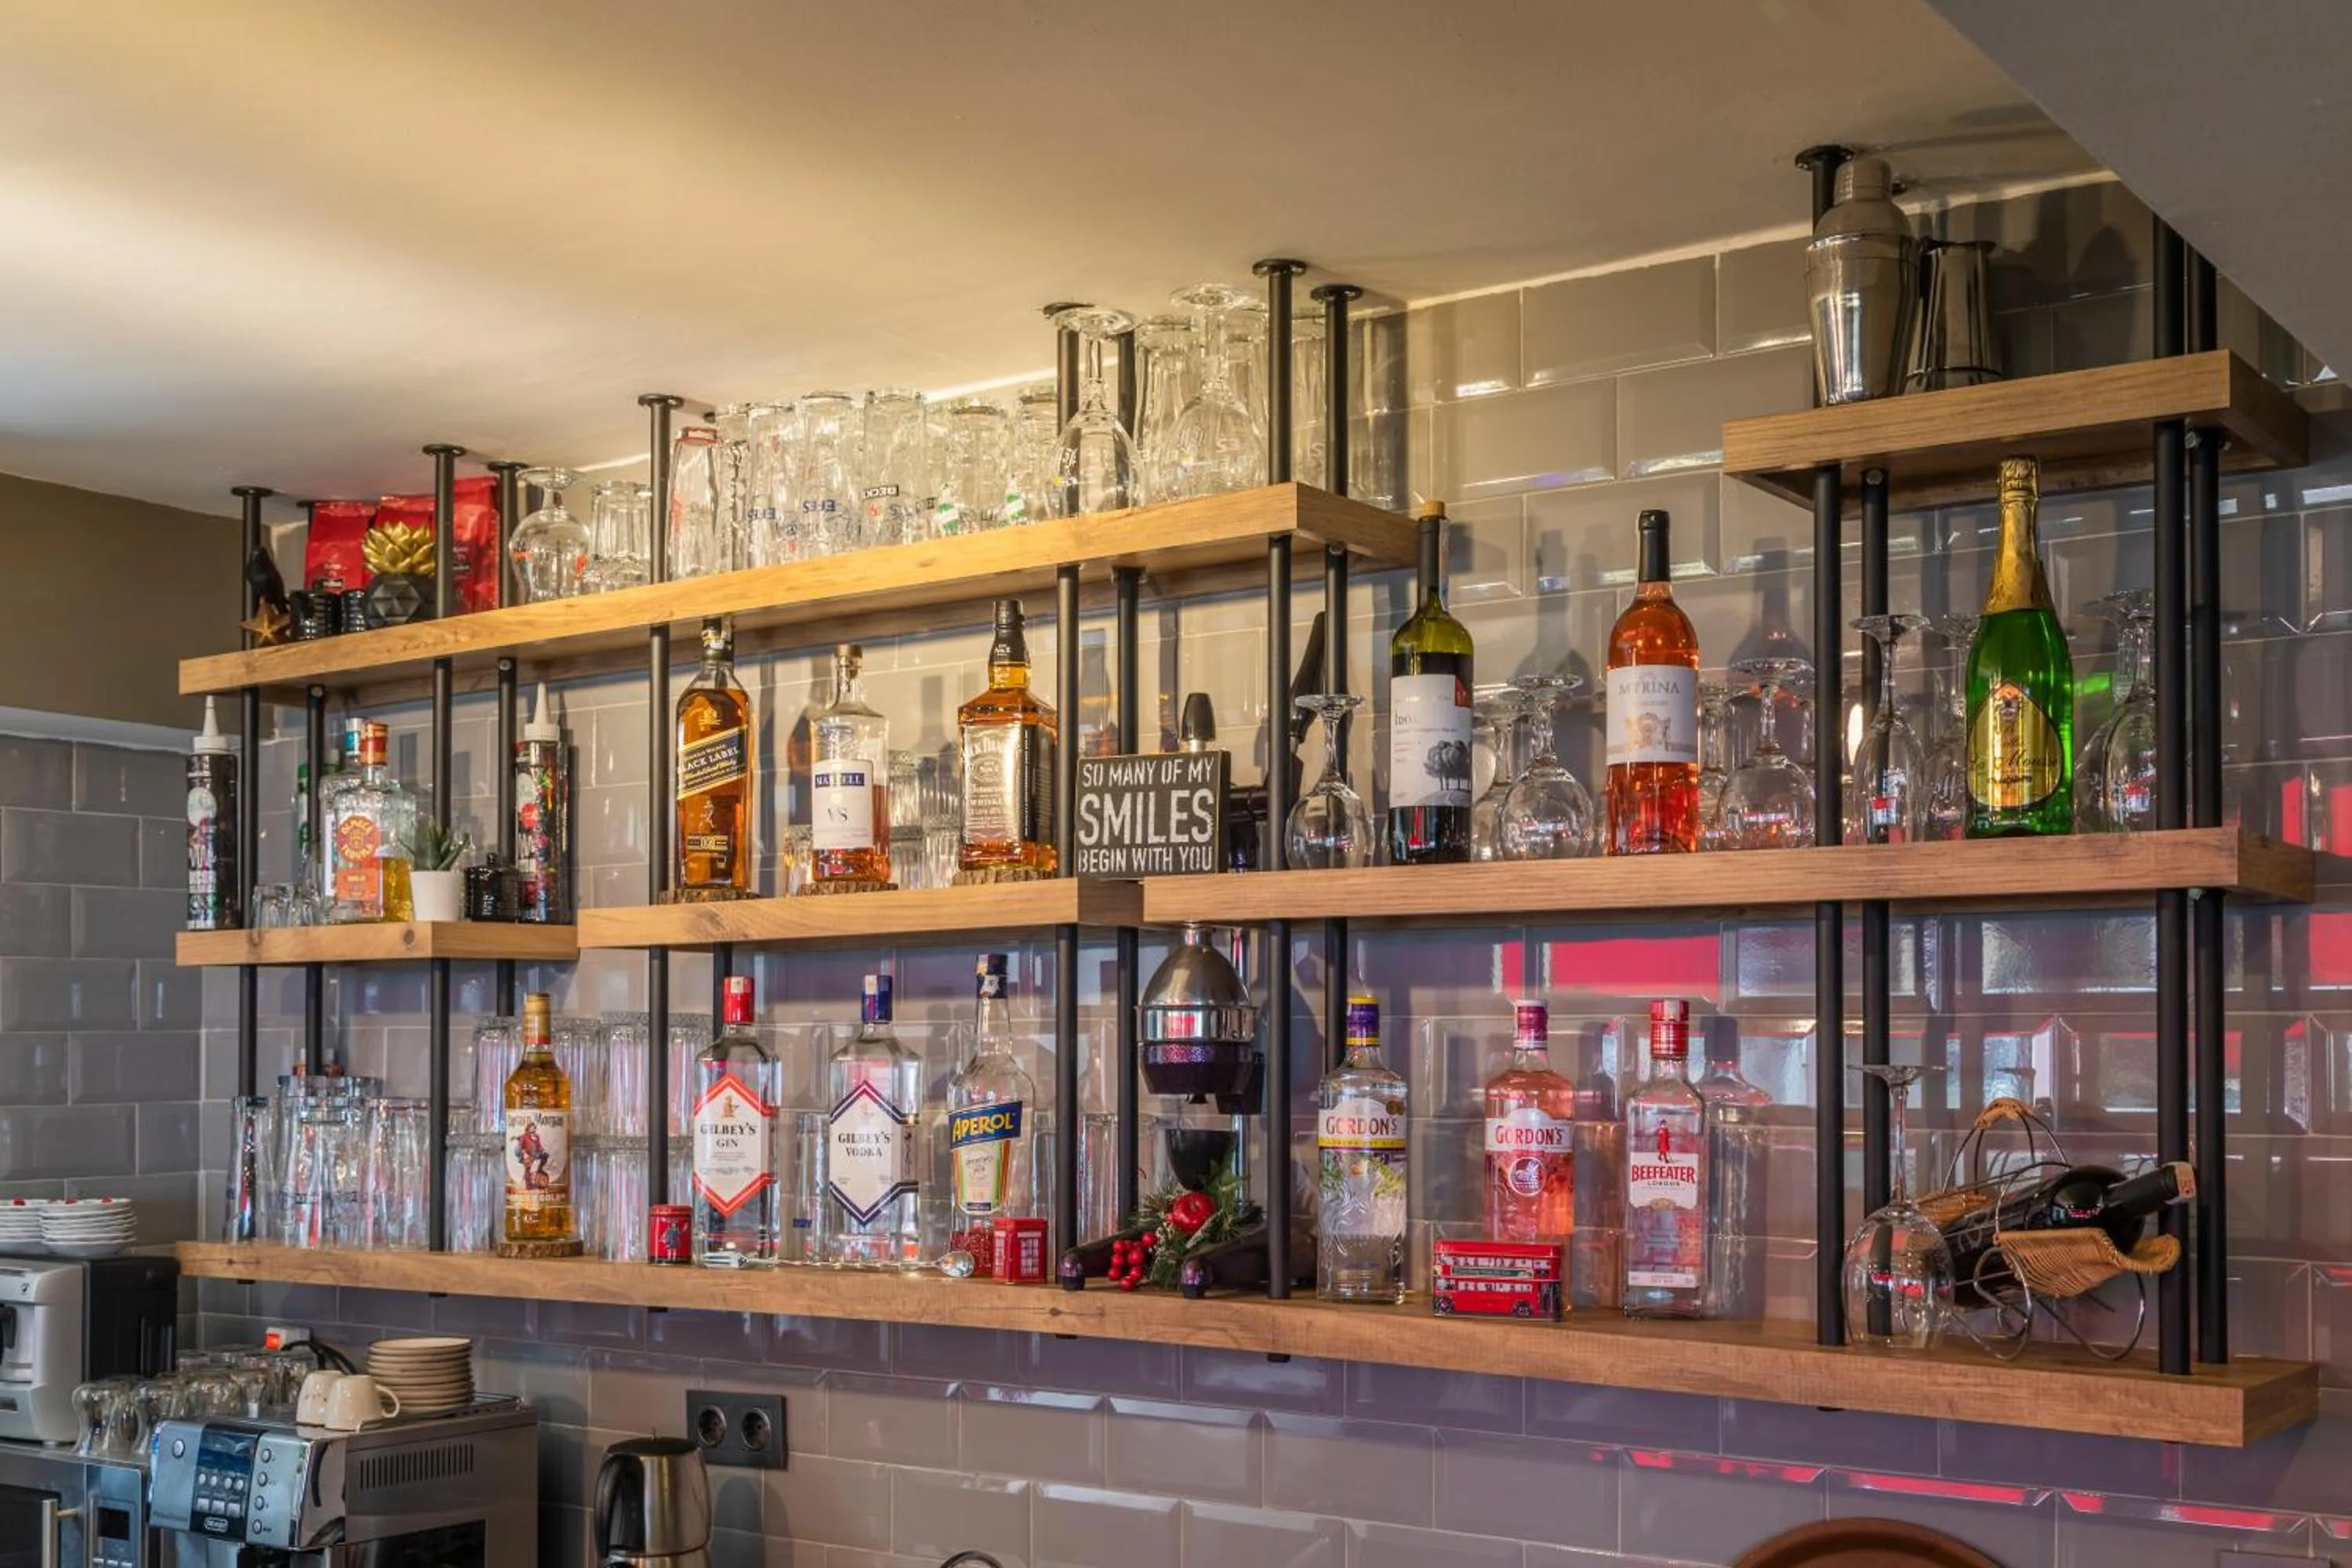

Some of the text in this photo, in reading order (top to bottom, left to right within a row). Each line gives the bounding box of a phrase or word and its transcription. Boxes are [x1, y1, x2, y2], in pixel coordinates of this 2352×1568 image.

[709, 746, 741, 763] LABEL
[816, 775, 862, 786] MAELL
[1083, 757, 1214, 787] SO MANY OF MY
[1078, 788, 1214, 846] SMILES
[1078, 846, 1213, 873] BEGIN WITH YOU
[700, 1122, 756, 1135] GILBEY'S
[953, 1112, 1014, 1142] APEROL
[1495, 1125, 1563, 1145] GORDON'S
[838, 1131, 891, 1144] GILBEY'S
[846, 1147, 883, 1157] VODKA
[1632, 1165, 1696, 1184] BEEFEATER
